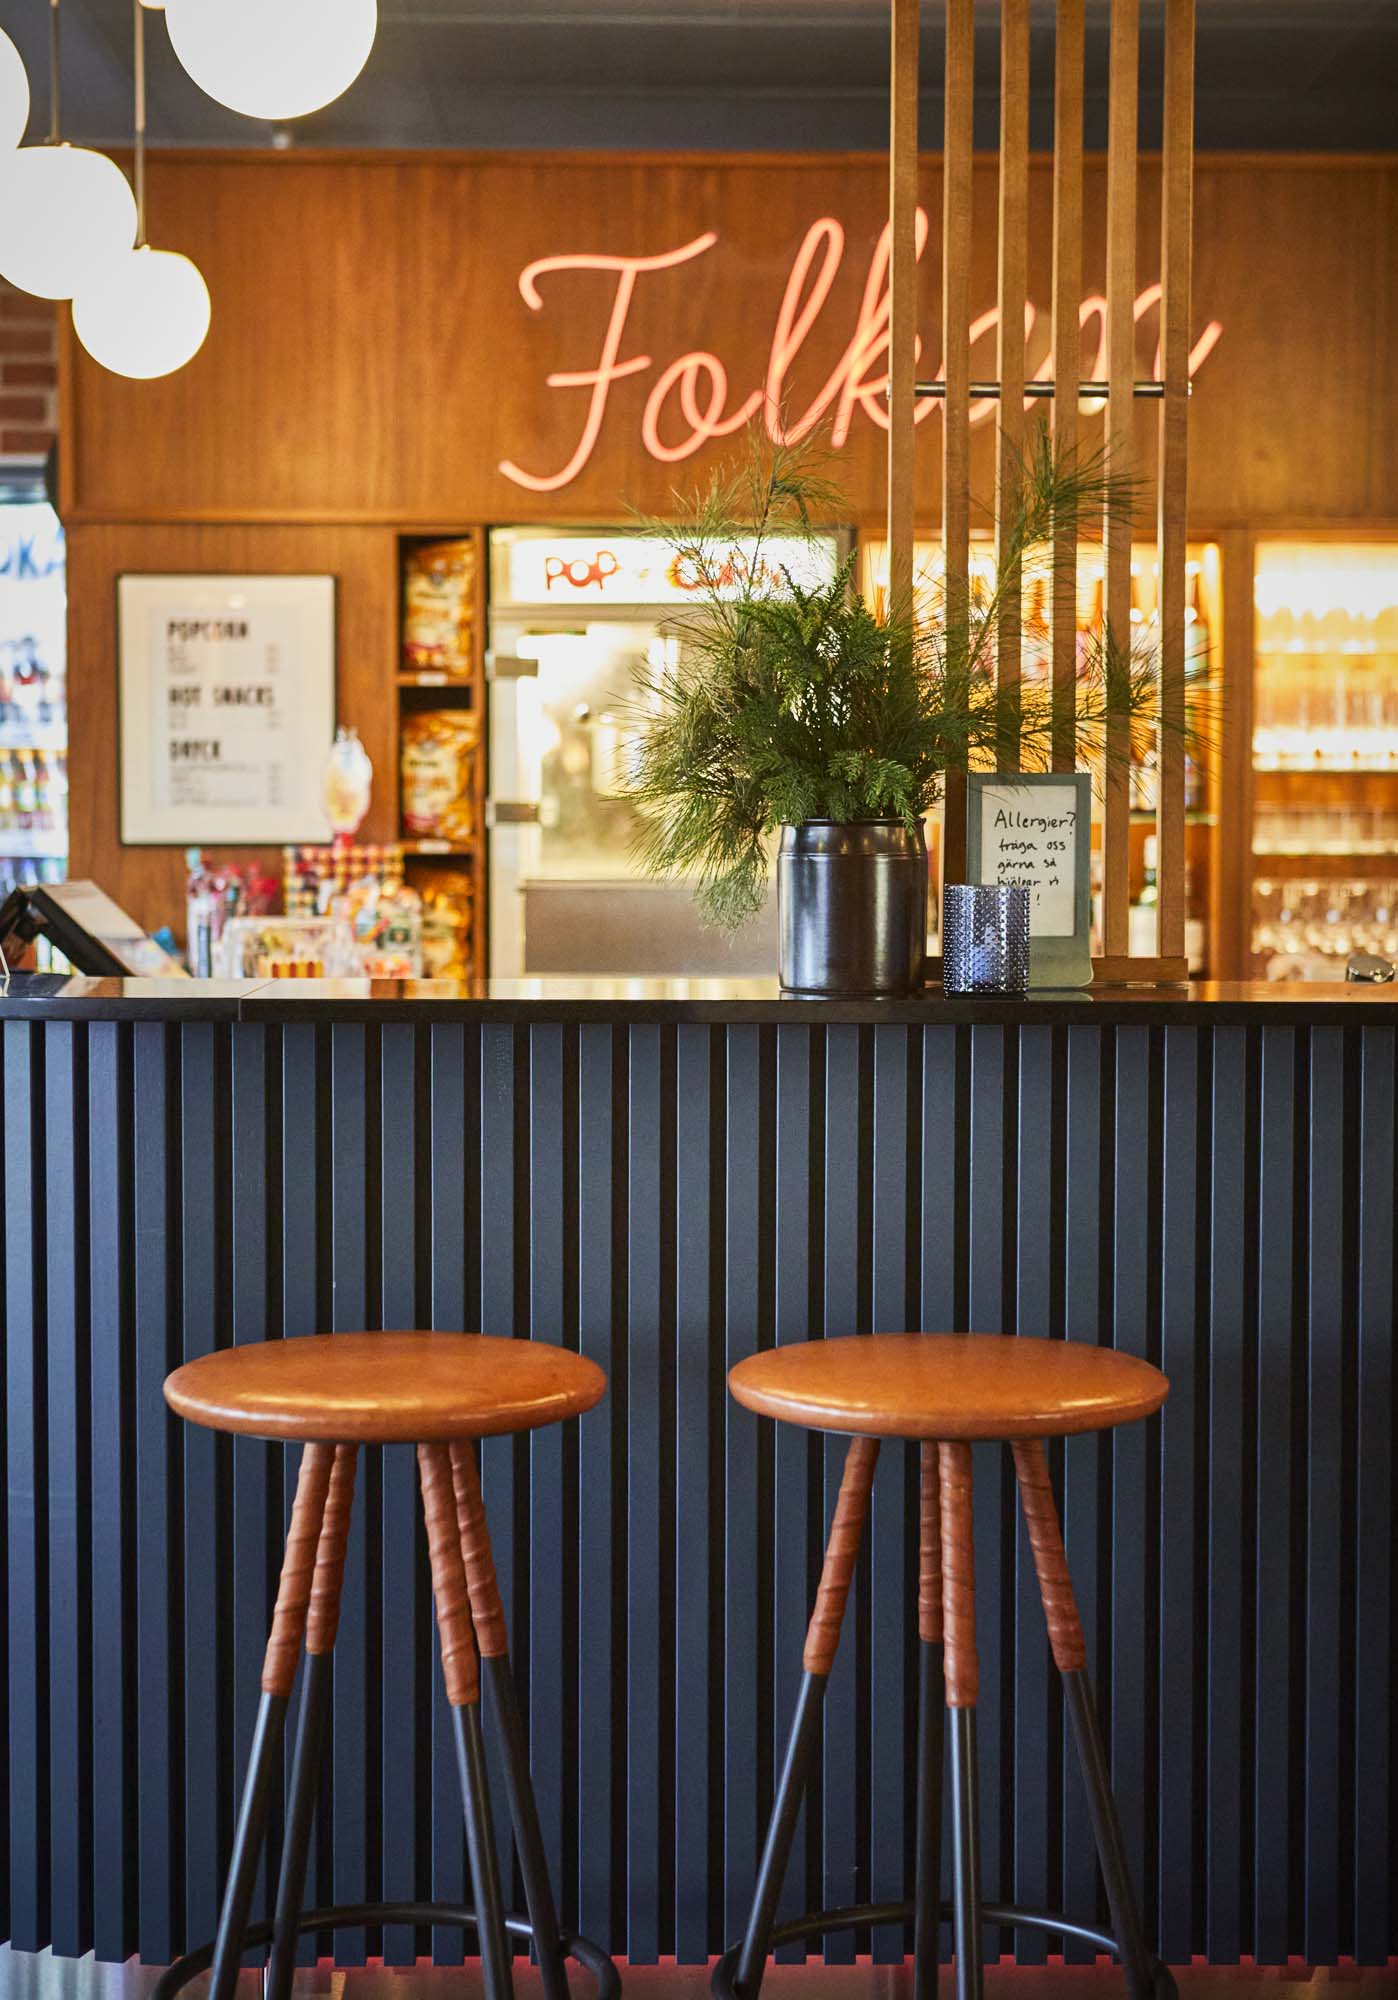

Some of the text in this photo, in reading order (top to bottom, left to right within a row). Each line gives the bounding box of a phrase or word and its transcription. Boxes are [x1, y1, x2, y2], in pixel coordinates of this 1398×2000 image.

[168, 620, 249, 641] POPCORN
[170, 686, 274, 706] HOT SNACKS
[170, 741, 220, 760] DRYCK
[994, 808, 1076, 836] Allergier?
[1046, 841, 1067, 851] oss
[998, 859, 1035, 874] gärna
